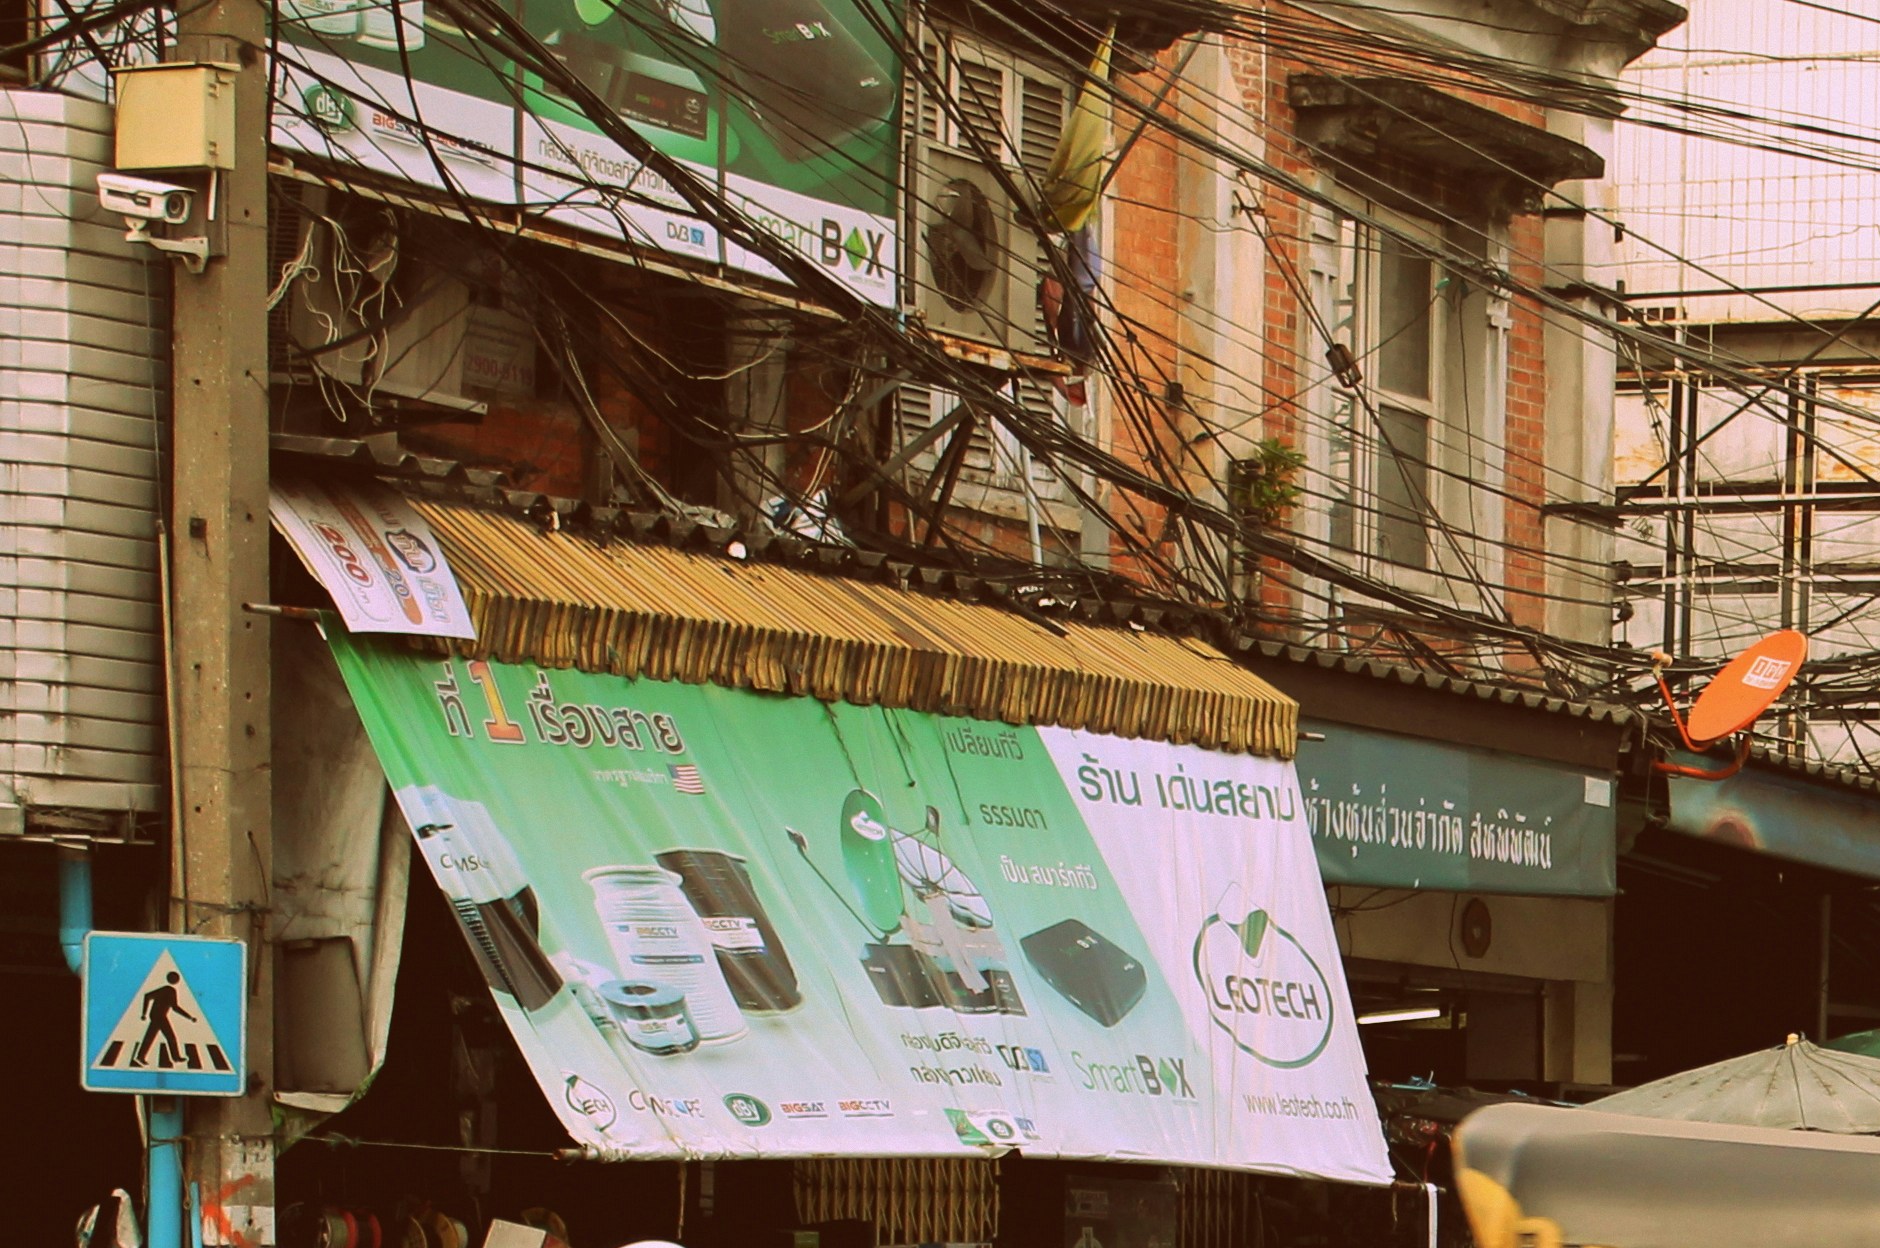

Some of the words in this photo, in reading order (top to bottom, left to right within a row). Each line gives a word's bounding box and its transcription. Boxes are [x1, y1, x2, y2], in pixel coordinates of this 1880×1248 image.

[316, 522, 372, 585] 200
[469, 660, 527, 744] 1
[979, 803, 1048, 831] ธรรมดา
[1078, 752, 1142, 810] ร้าน
[1156, 763, 1297, 823] เด่นสยาม
[1208, 973, 1323, 1022] LEOTECH
